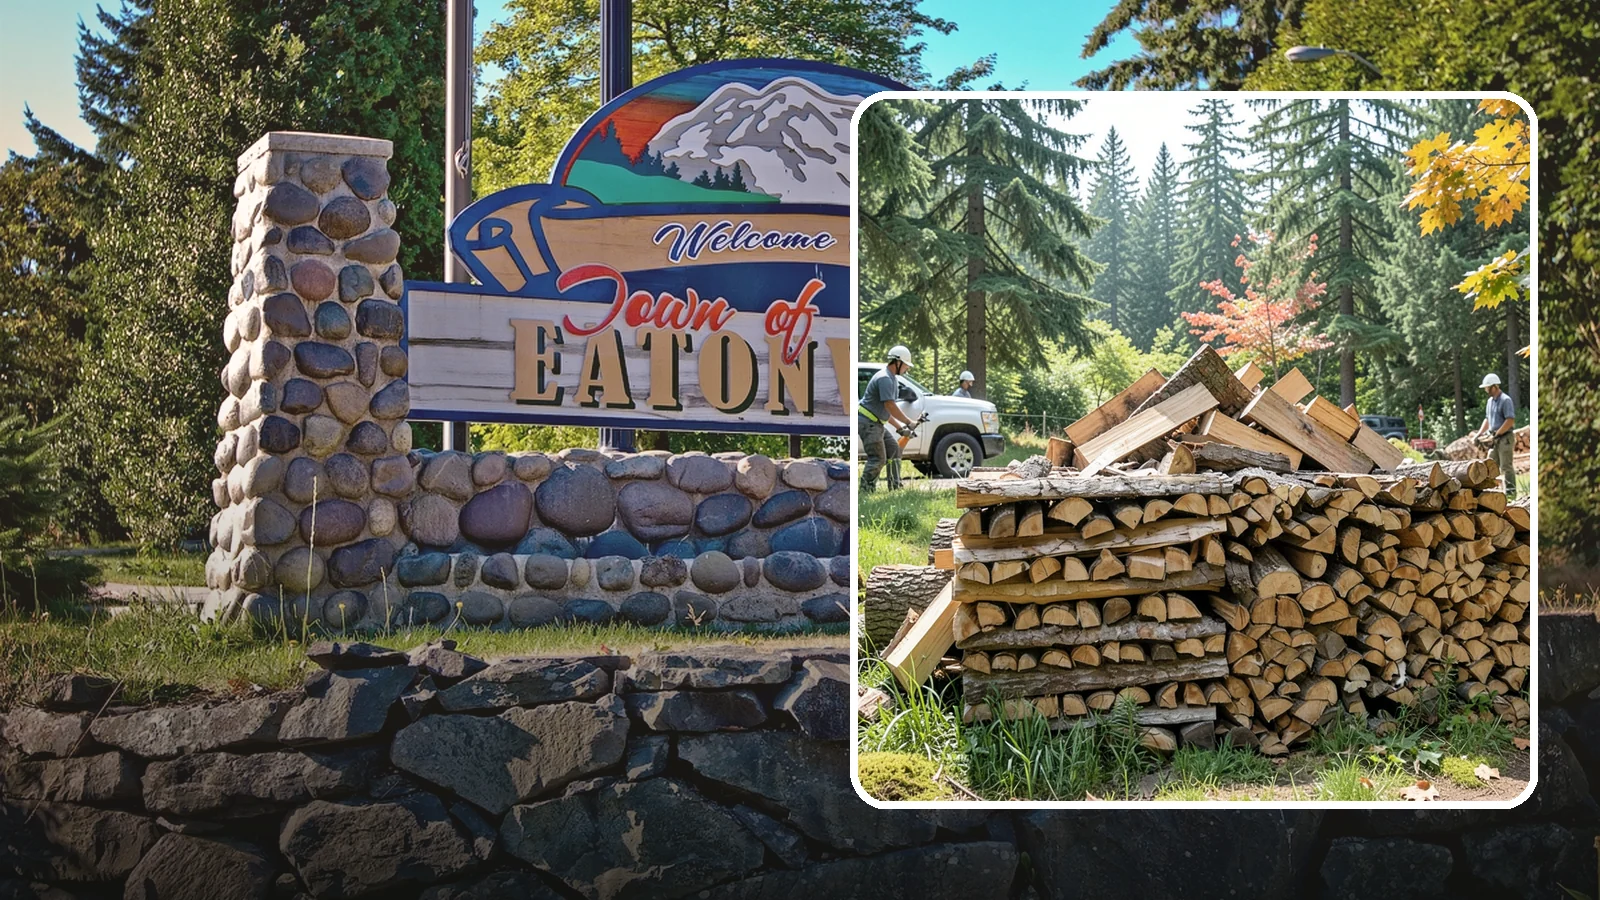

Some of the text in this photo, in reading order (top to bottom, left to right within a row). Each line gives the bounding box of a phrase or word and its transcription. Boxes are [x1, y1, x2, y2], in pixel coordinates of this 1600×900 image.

[653, 221, 836, 262] Welcome
[557, 264, 825, 364] Town of
